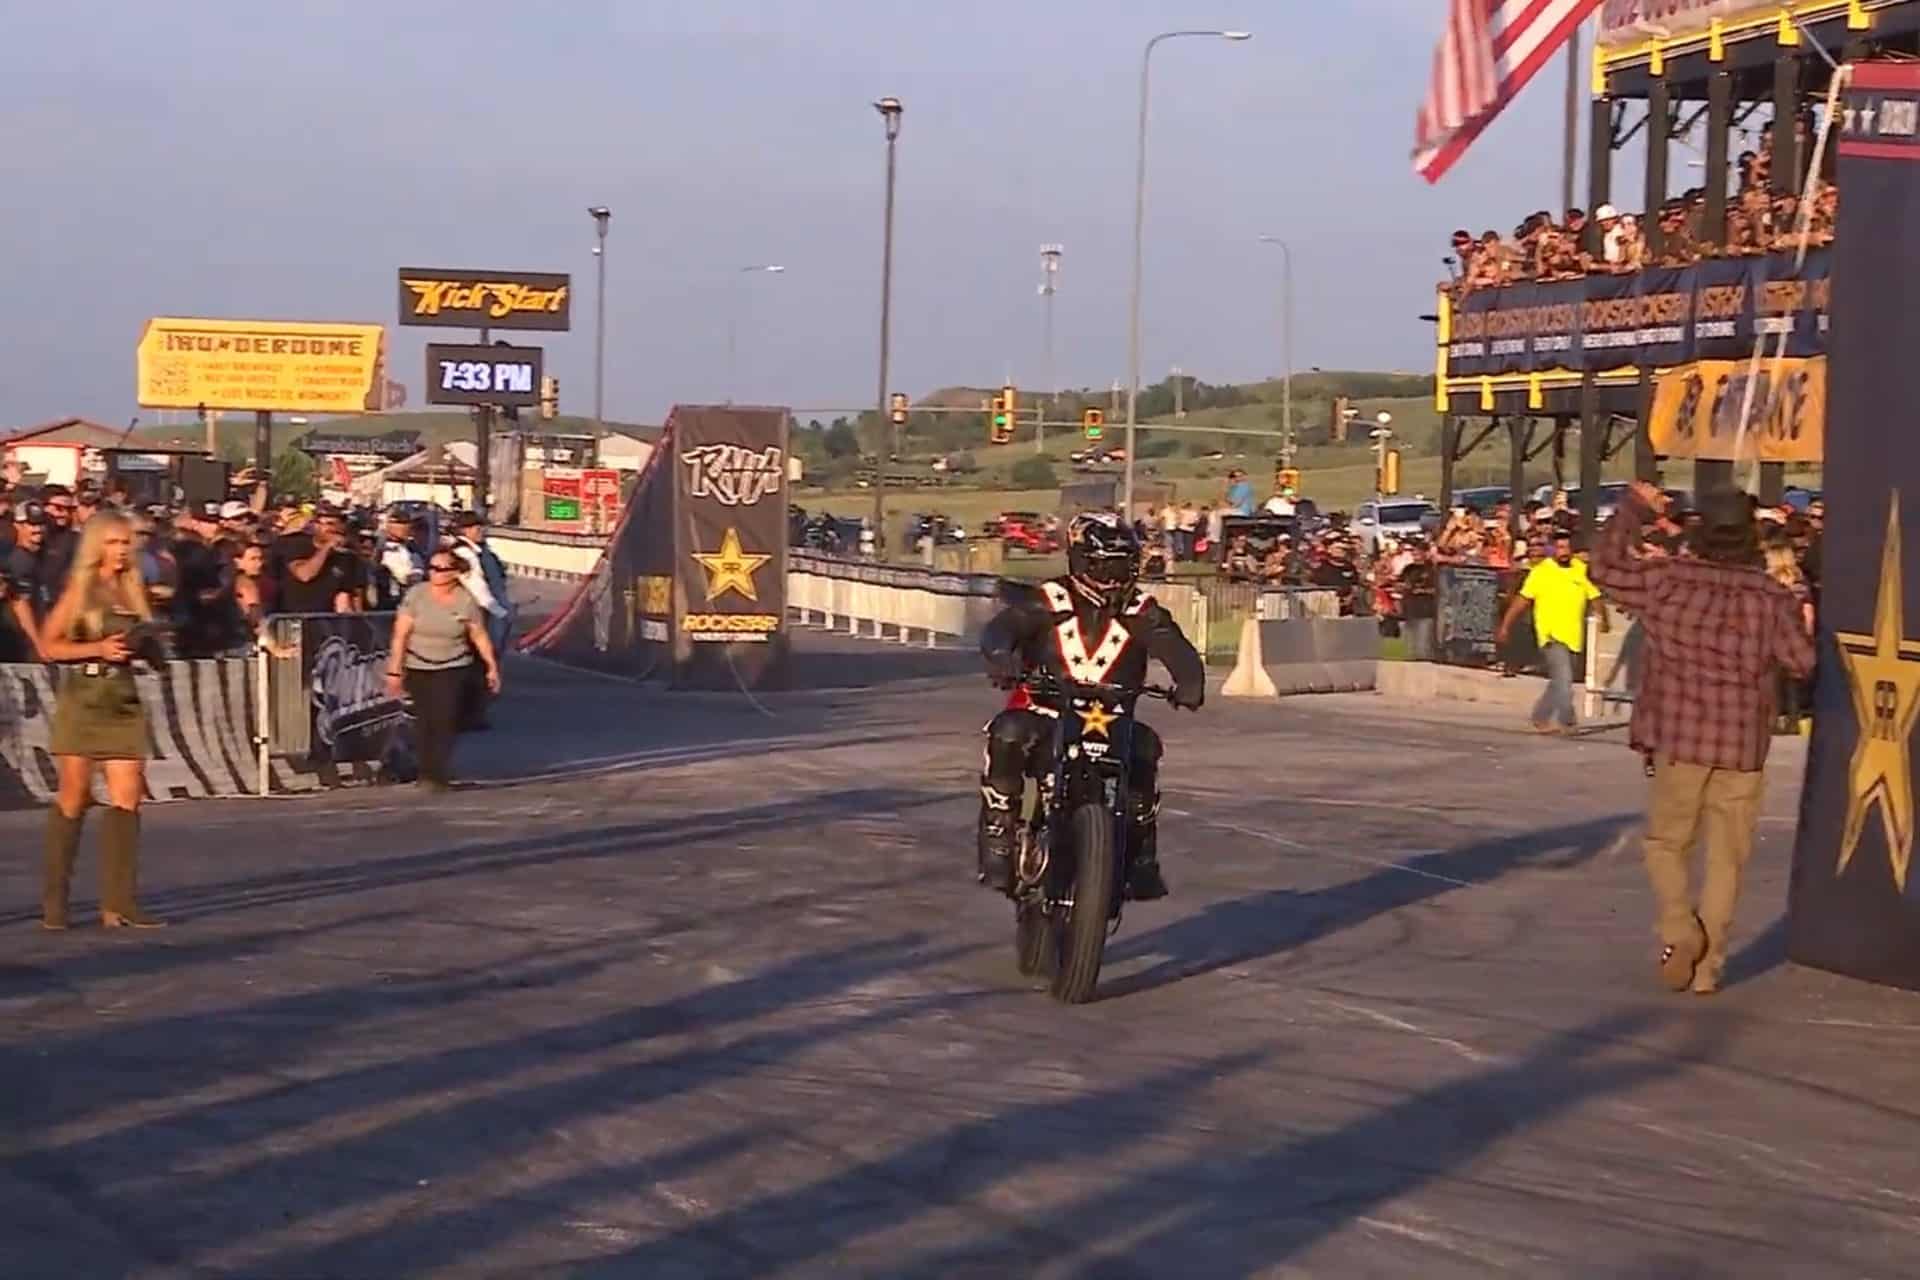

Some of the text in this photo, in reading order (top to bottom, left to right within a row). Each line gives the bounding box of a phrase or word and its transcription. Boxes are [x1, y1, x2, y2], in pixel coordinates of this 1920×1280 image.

[402, 279, 568, 318] Kick Start
[495, 363, 533, 392] PM
[681, 614, 779, 632] ROCKSTAR
